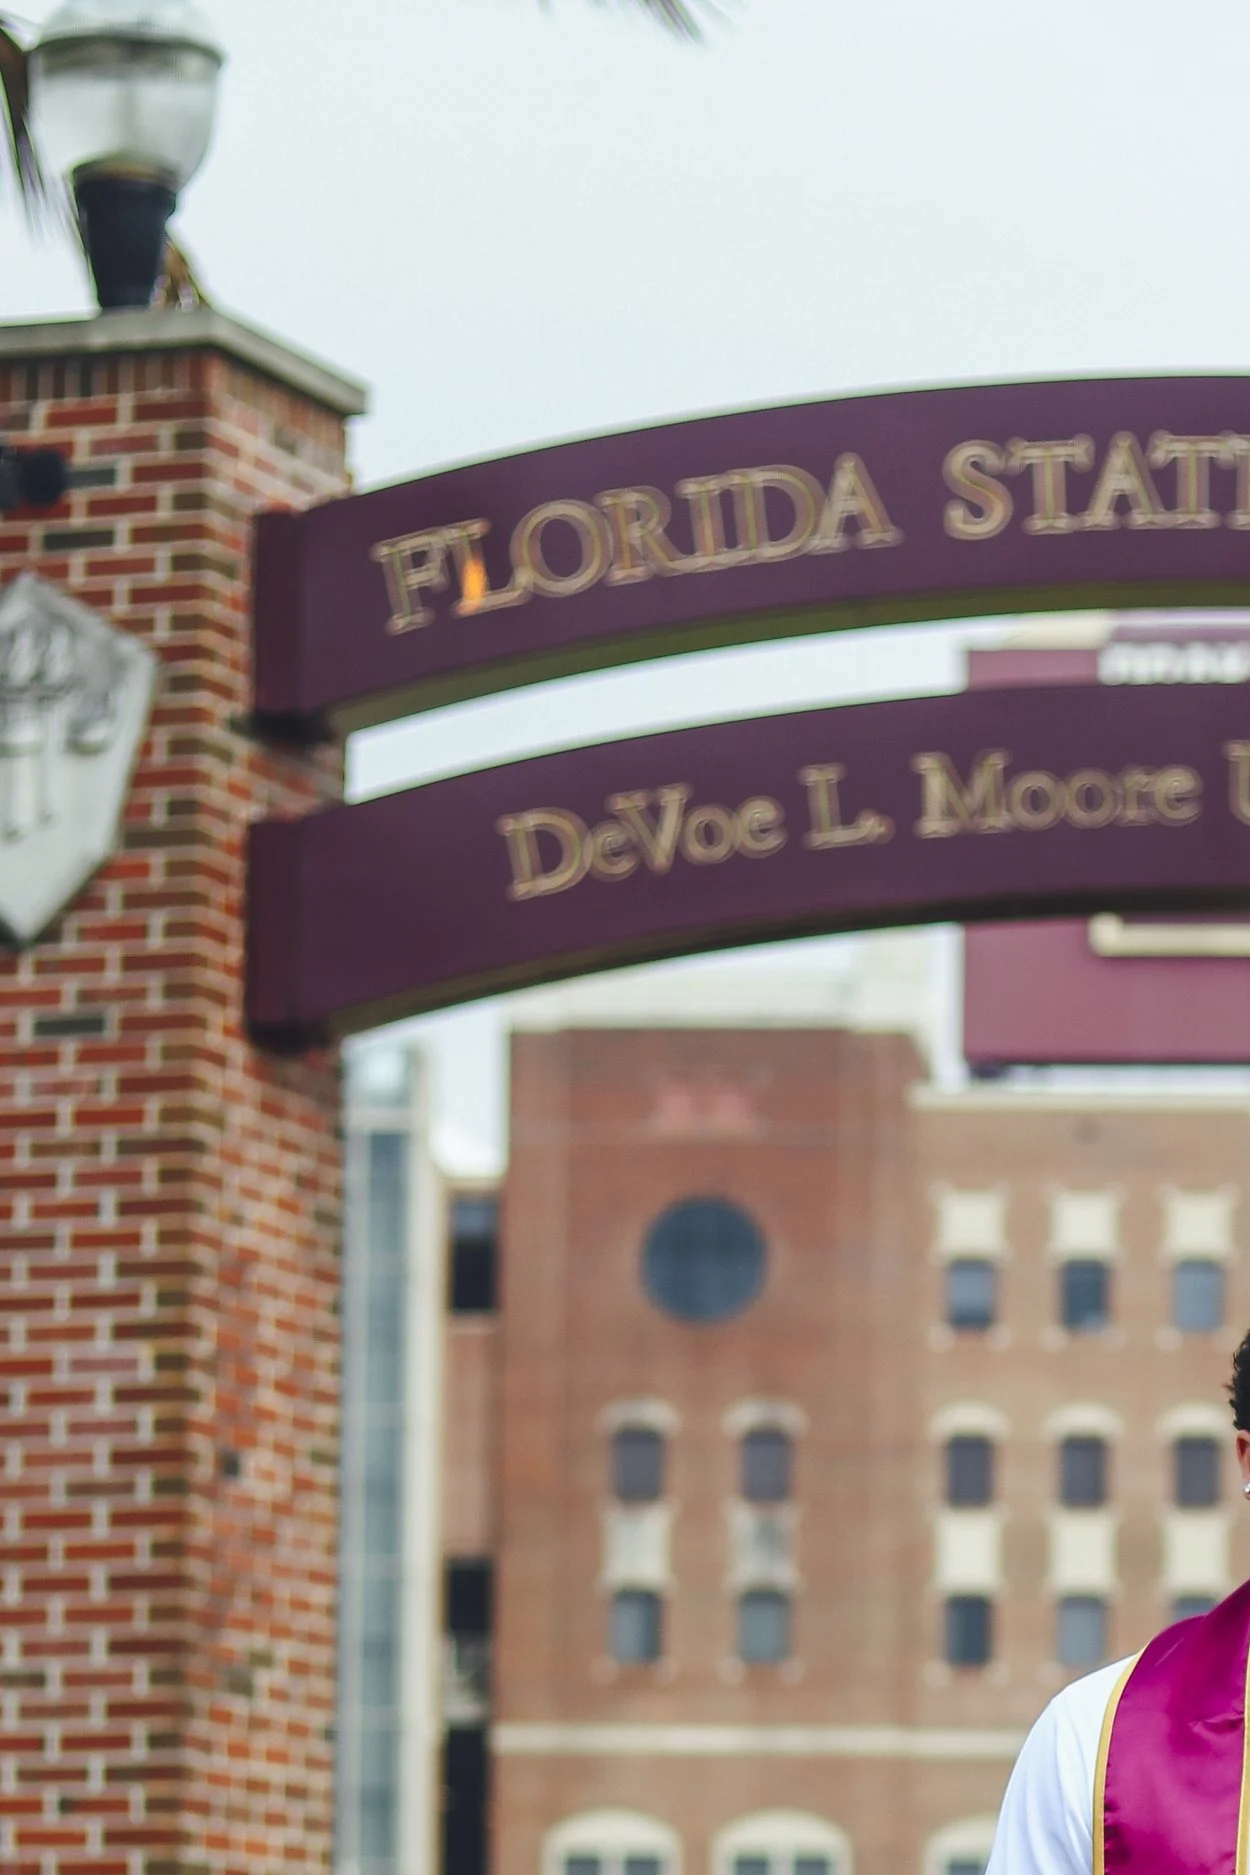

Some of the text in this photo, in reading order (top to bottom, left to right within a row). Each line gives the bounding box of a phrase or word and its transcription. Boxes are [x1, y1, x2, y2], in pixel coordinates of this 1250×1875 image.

[372, 452, 904, 636] FLORIDA
[496, 782, 787, 901] DeVoe
[911, 747, 1202, 839] Moore
